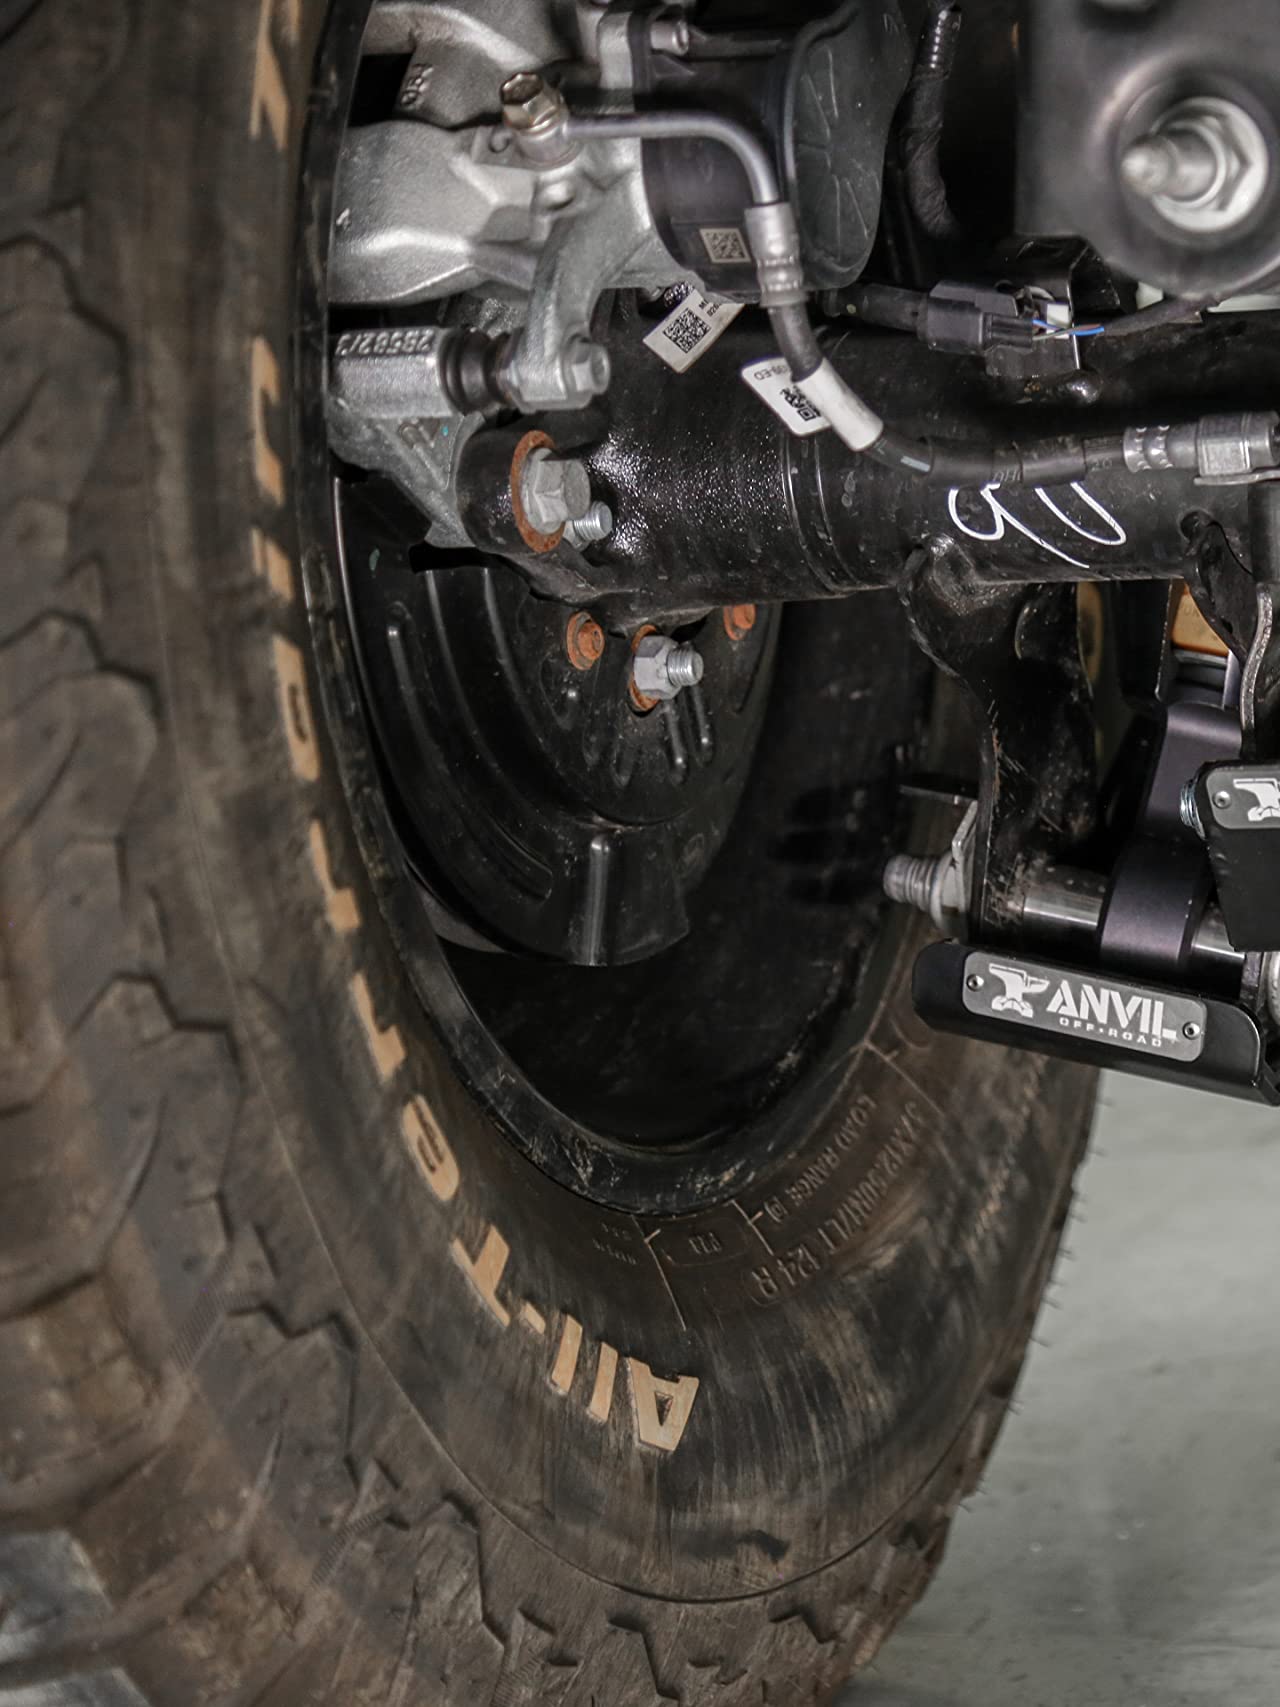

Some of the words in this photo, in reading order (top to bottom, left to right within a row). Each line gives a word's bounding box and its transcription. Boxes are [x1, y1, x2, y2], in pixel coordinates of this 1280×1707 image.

[1046, 979, 1177, 1041] ANVIL
[834, 1094, 876, 1151] LOAD
[785, 1146, 840, 1206] RANGE
